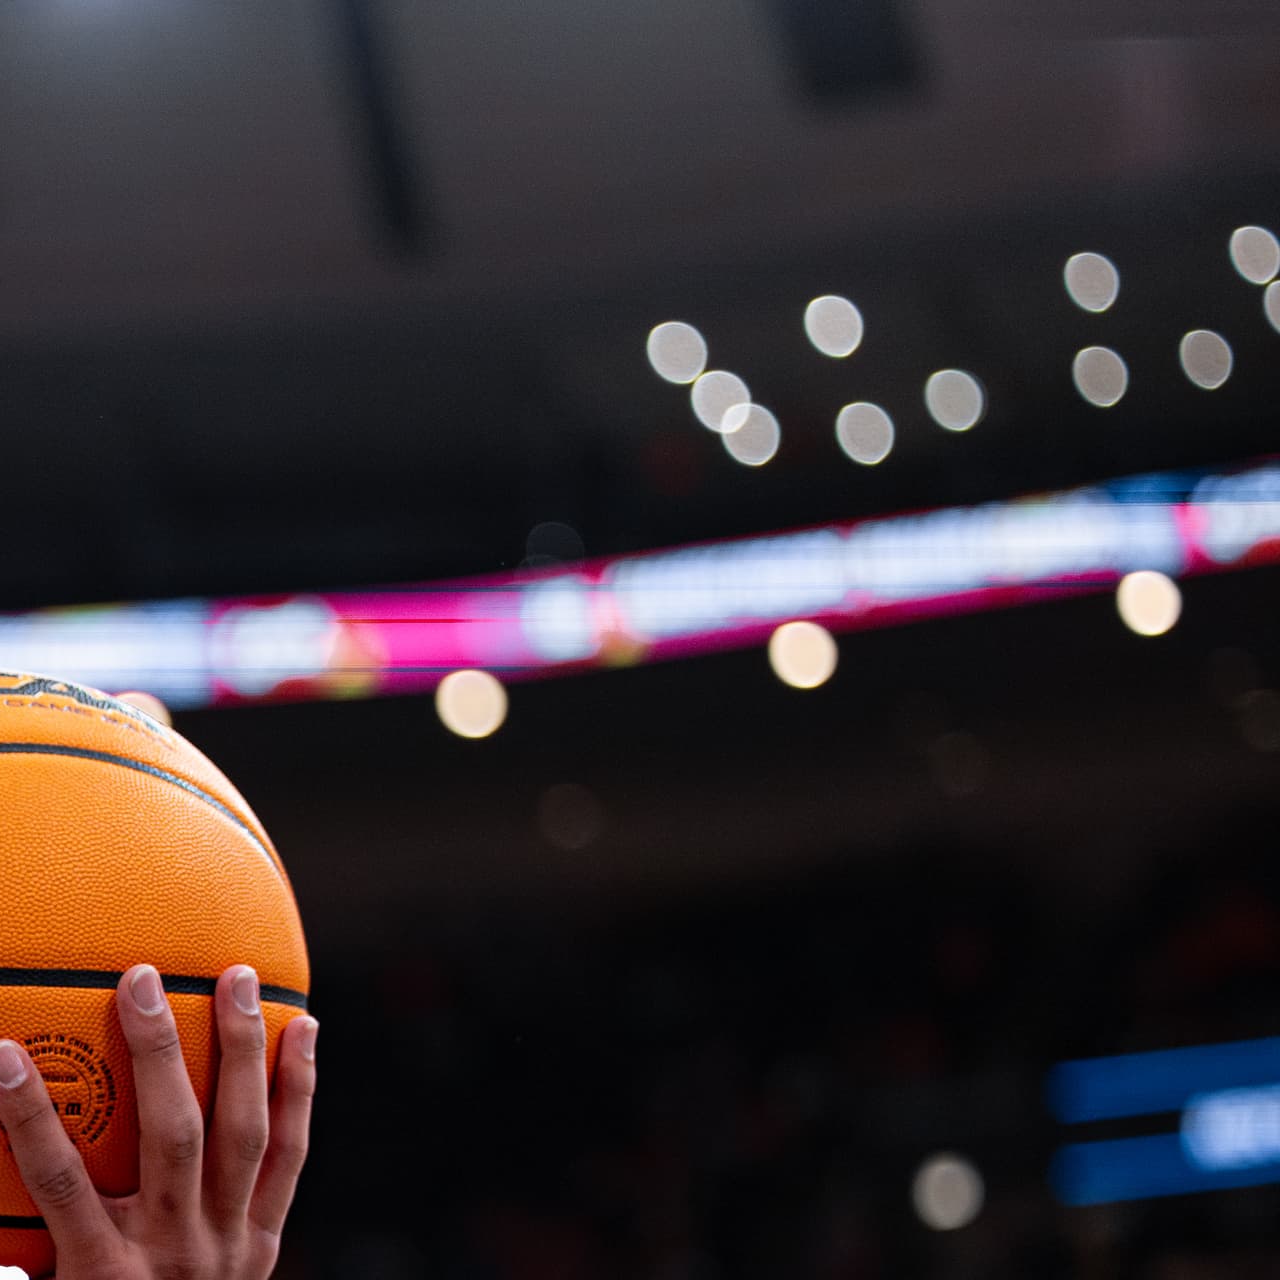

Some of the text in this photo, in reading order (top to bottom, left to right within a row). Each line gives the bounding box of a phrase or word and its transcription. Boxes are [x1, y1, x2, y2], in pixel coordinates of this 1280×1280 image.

[24, 1033, 51, 1046] MADE
[55, 1033, 65, 1043] IN
[68, 1036, 94, 1056] CHINA
